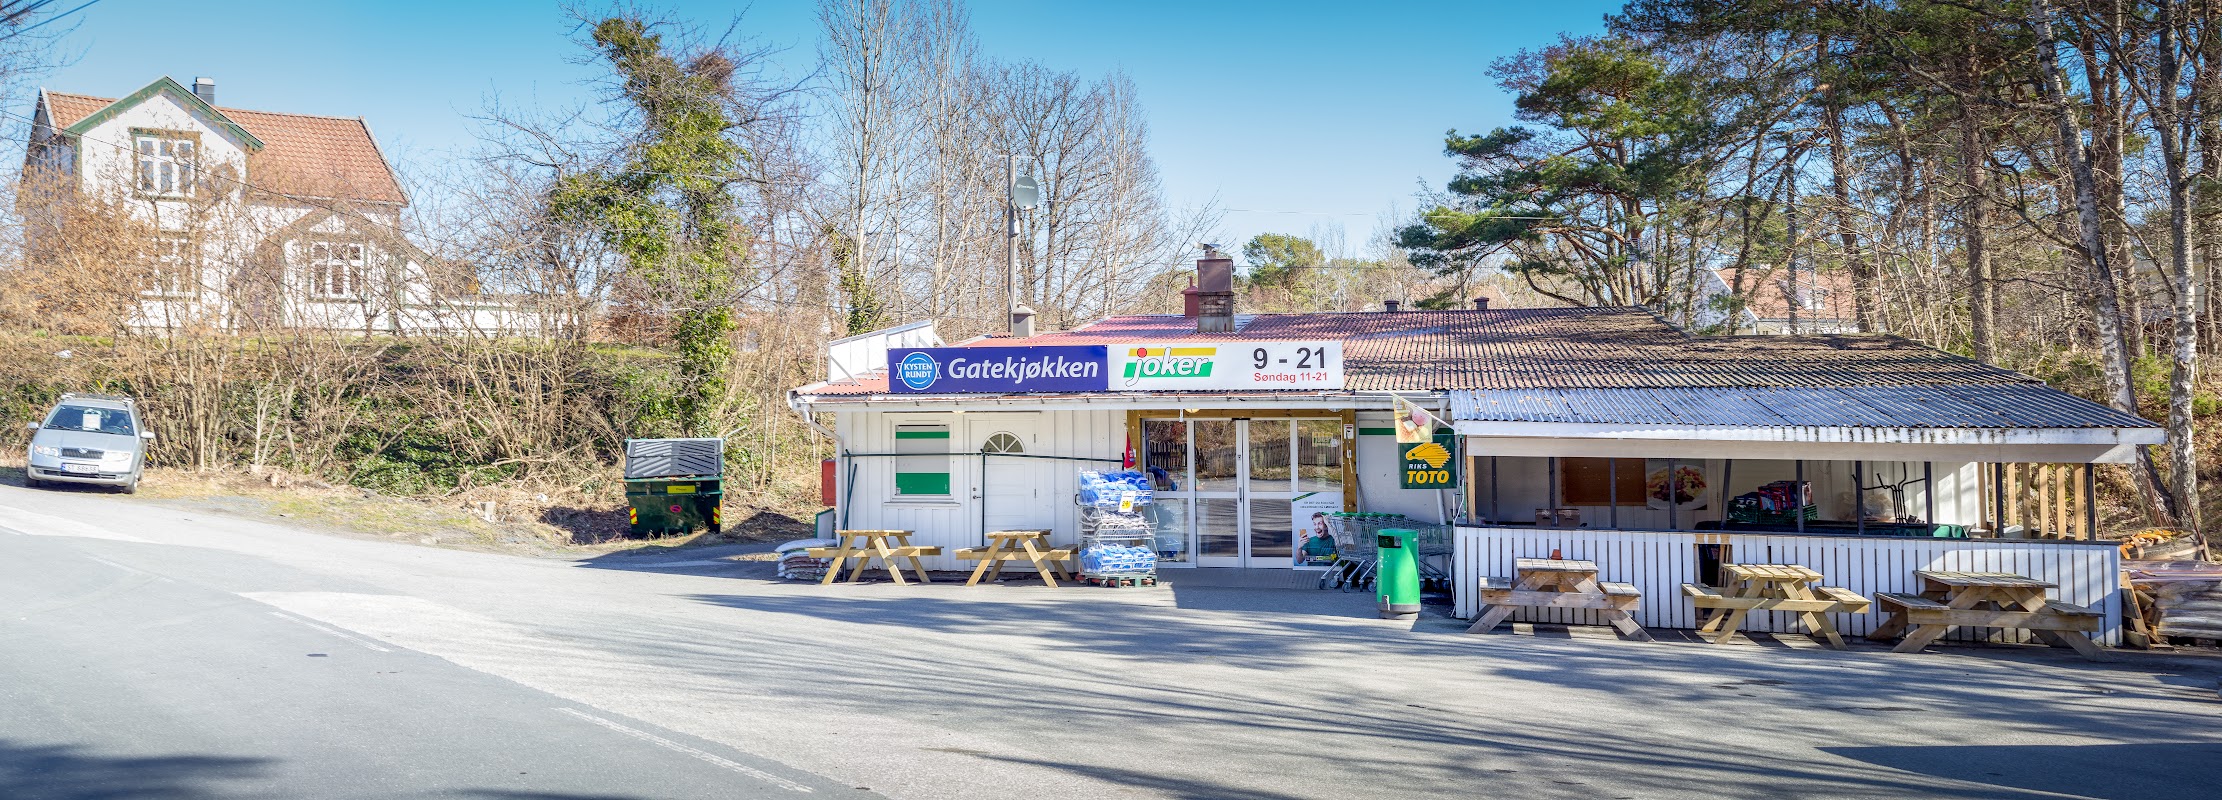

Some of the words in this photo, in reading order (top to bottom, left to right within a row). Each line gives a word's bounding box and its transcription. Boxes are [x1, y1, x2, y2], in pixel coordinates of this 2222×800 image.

[1253, 347, 1268, 369] 9
[1296, 346, 1325, 369] 21
[904, 363, 933, 371] KYSTEN
[905, 370, 932, 378] RUNDT
[948, 355, 1099, 384] Gatekjøkken
[1125, 347, 1210, 387] joker
[1254, 372, 1296, 384] Søndag
[1299, 371, 1328, 381] 11-21
[1407, 470, 1450, 484] TOTO
